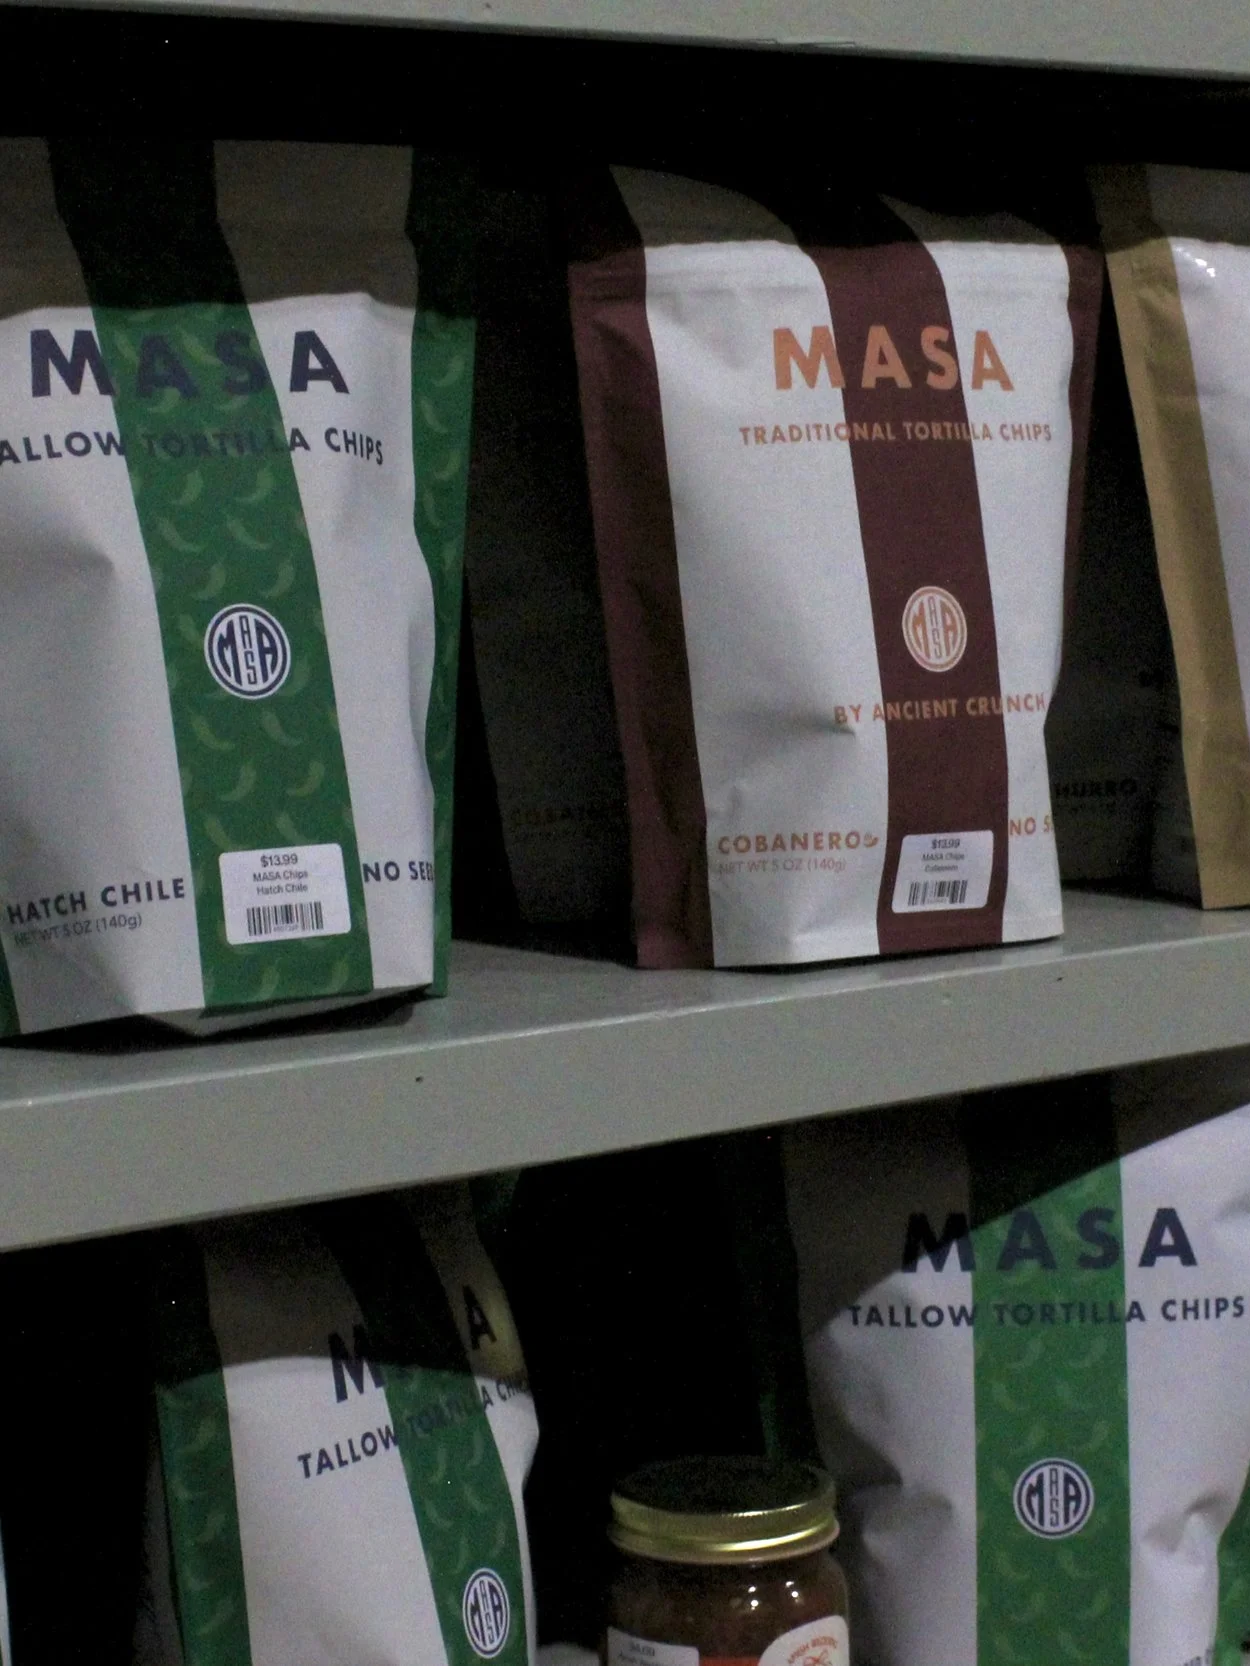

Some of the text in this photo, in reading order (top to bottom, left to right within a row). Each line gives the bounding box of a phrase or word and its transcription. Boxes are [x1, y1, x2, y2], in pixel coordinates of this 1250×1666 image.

[30, 329, 349, 398] MASA
[773, 325, 1014, 391] MASA
[740, 421, 1052, 446] TRADITIONAL TORTILLA CHIPS
[324, 427, 383, 466] CHIPS
[834, 692, 1046, 725] BY ANCIENT CRUNCH
[1010, 816, 1036, 836] NO
[718, 831, 861, 855] COBANERO
[260, 852, 298, 868] $13.99
[363, 860, 434, 883] NO SEE
[719, 861, 745, 875] NET
[747, 860, 768, 873] WT
[771, 858, 779, 872] 5
[783, 857, 803, 872] OZ
[253, 868, 309, 883] MASA Chips
[7, 877, 185, 925] HATCH CHILE
[257, 883, 283, 895] Hatch
[73, 920, 93, 936] OZ
[96, 912, 143, 933] (140g)
[902, 1207, 1197, 1274] MASA
[847, 1295, 1246, 1329] TALLOW TORTILLA CHIPS
[298, 1424, 399, 1480] TALLOW
